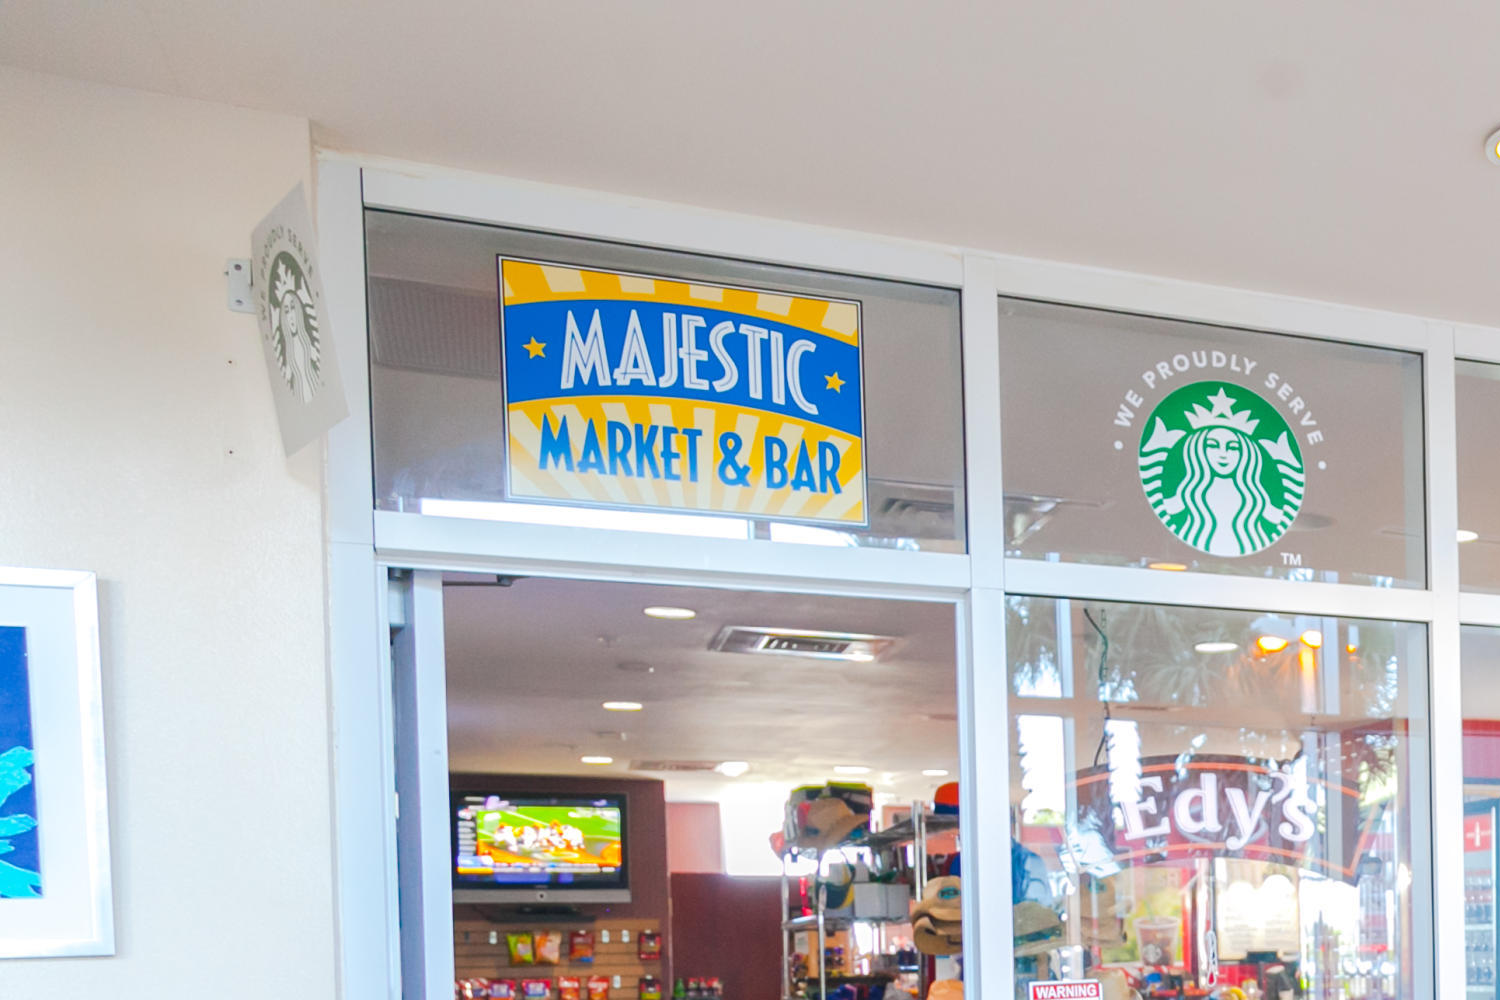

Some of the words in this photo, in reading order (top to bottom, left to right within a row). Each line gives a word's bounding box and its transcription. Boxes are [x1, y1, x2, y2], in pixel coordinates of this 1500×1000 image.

[560, 308, 819, 415] MAJESTIC
[1114, 389, 1144, 428] WE
[1142, 350, 1257, 389] PROUDLY
[1264, 372, 1324, 445] SERVE
[538, 412, 702, 482] MARKET
[718, 431, 752, 488] &
[764, 435, 842, 494] BAR
[1280, 552, 1302, 566] TM
[1120, 769, 1318, 850] Edy's
[1035, 983, 1098, 999] WARNING
